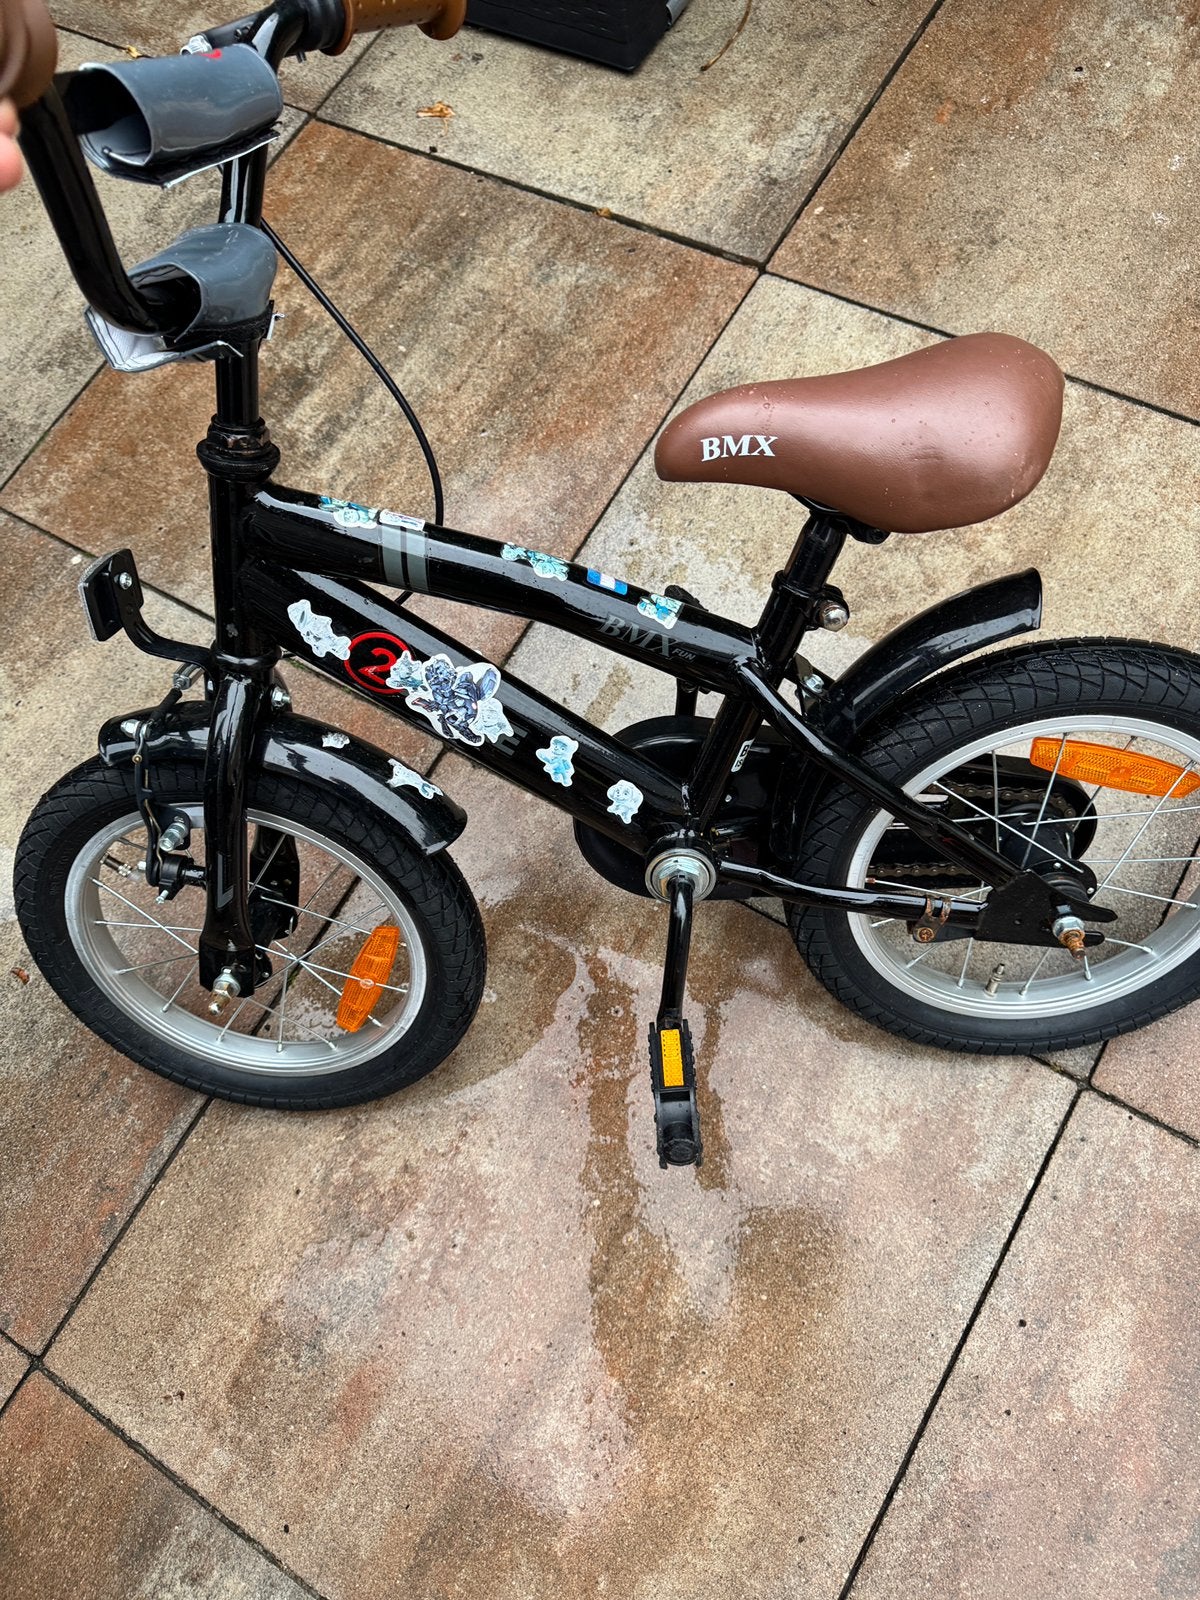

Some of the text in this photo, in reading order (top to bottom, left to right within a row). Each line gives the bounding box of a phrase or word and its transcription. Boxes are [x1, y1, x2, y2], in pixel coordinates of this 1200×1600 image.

[700, 434, 779, 462] BMX
[597, 613, 697, 662] BMX FUN
[358, 648, 397, 685] 2
